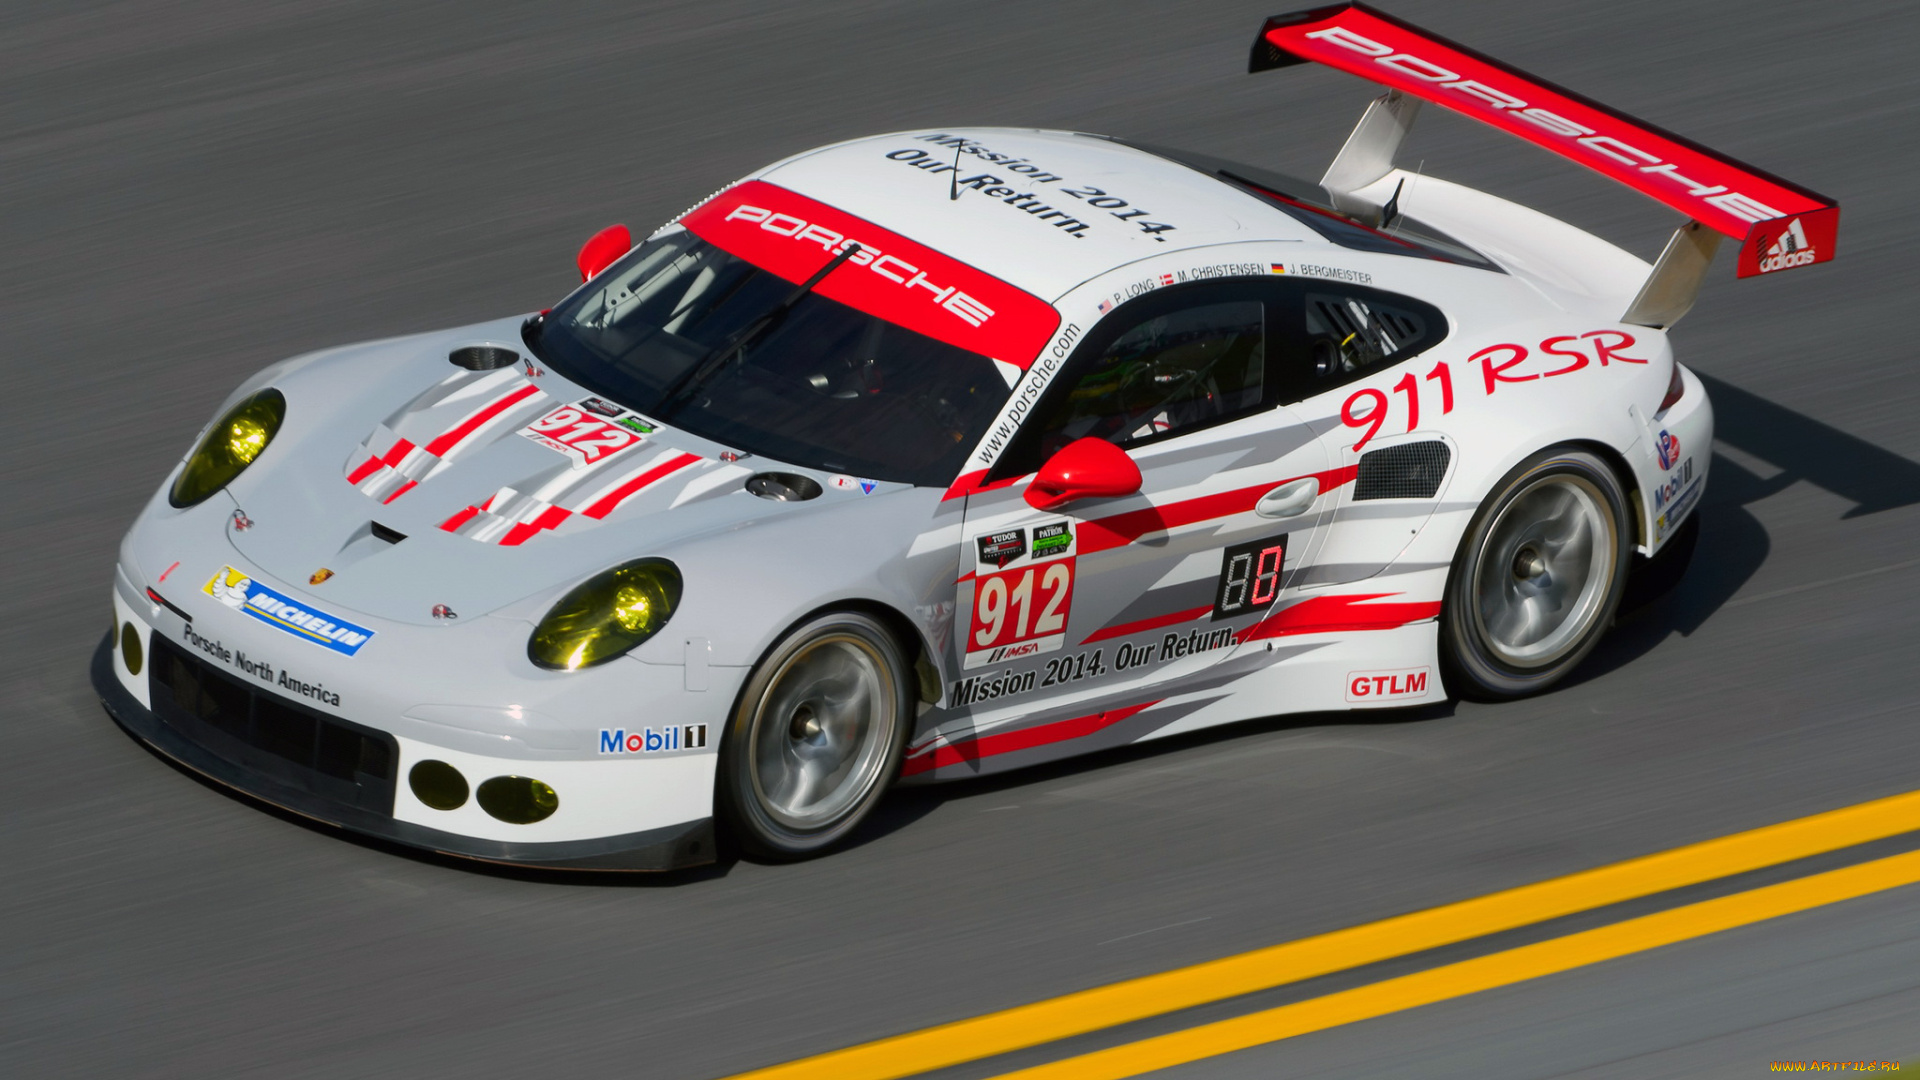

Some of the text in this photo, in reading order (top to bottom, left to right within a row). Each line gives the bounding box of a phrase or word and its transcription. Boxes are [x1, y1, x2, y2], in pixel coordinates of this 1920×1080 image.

[1305, 26, 1788, 223] PORSCHE
[886, 149, 1090, 239] Our Return.
[913, 134, 1177, 242] Mission 2014.
[725, 204, 995, 327] PORSCHE
[1177, 263, 1265, 283] M. CHRISTENSEN
[1290, 264, 1372, 284] J. BERGMEISTER
[1760, 250, 1815, 273] adidas
[1113, 279, 1155, 304] P. LONG
[978, 323, 1081, 464] www.porsche.com
[1341, 330, 1649, 453] 911 RSR
[529, 409, 631, 459] 912
[992, 532, 1017, 543] TUDOR
[249, 592, 367, 647] MICHELIN
[975, 563, 1070, 646] 912
[184, 623, 340, 707] Porsche North America
[950, 627, 1237, 708] Mission 2014. Our Return.
[1004, 643, 1038, 658] IMSA
[1351, 672, 1426, 696] GTLM
[600, 727, 678, 753] Mobil
